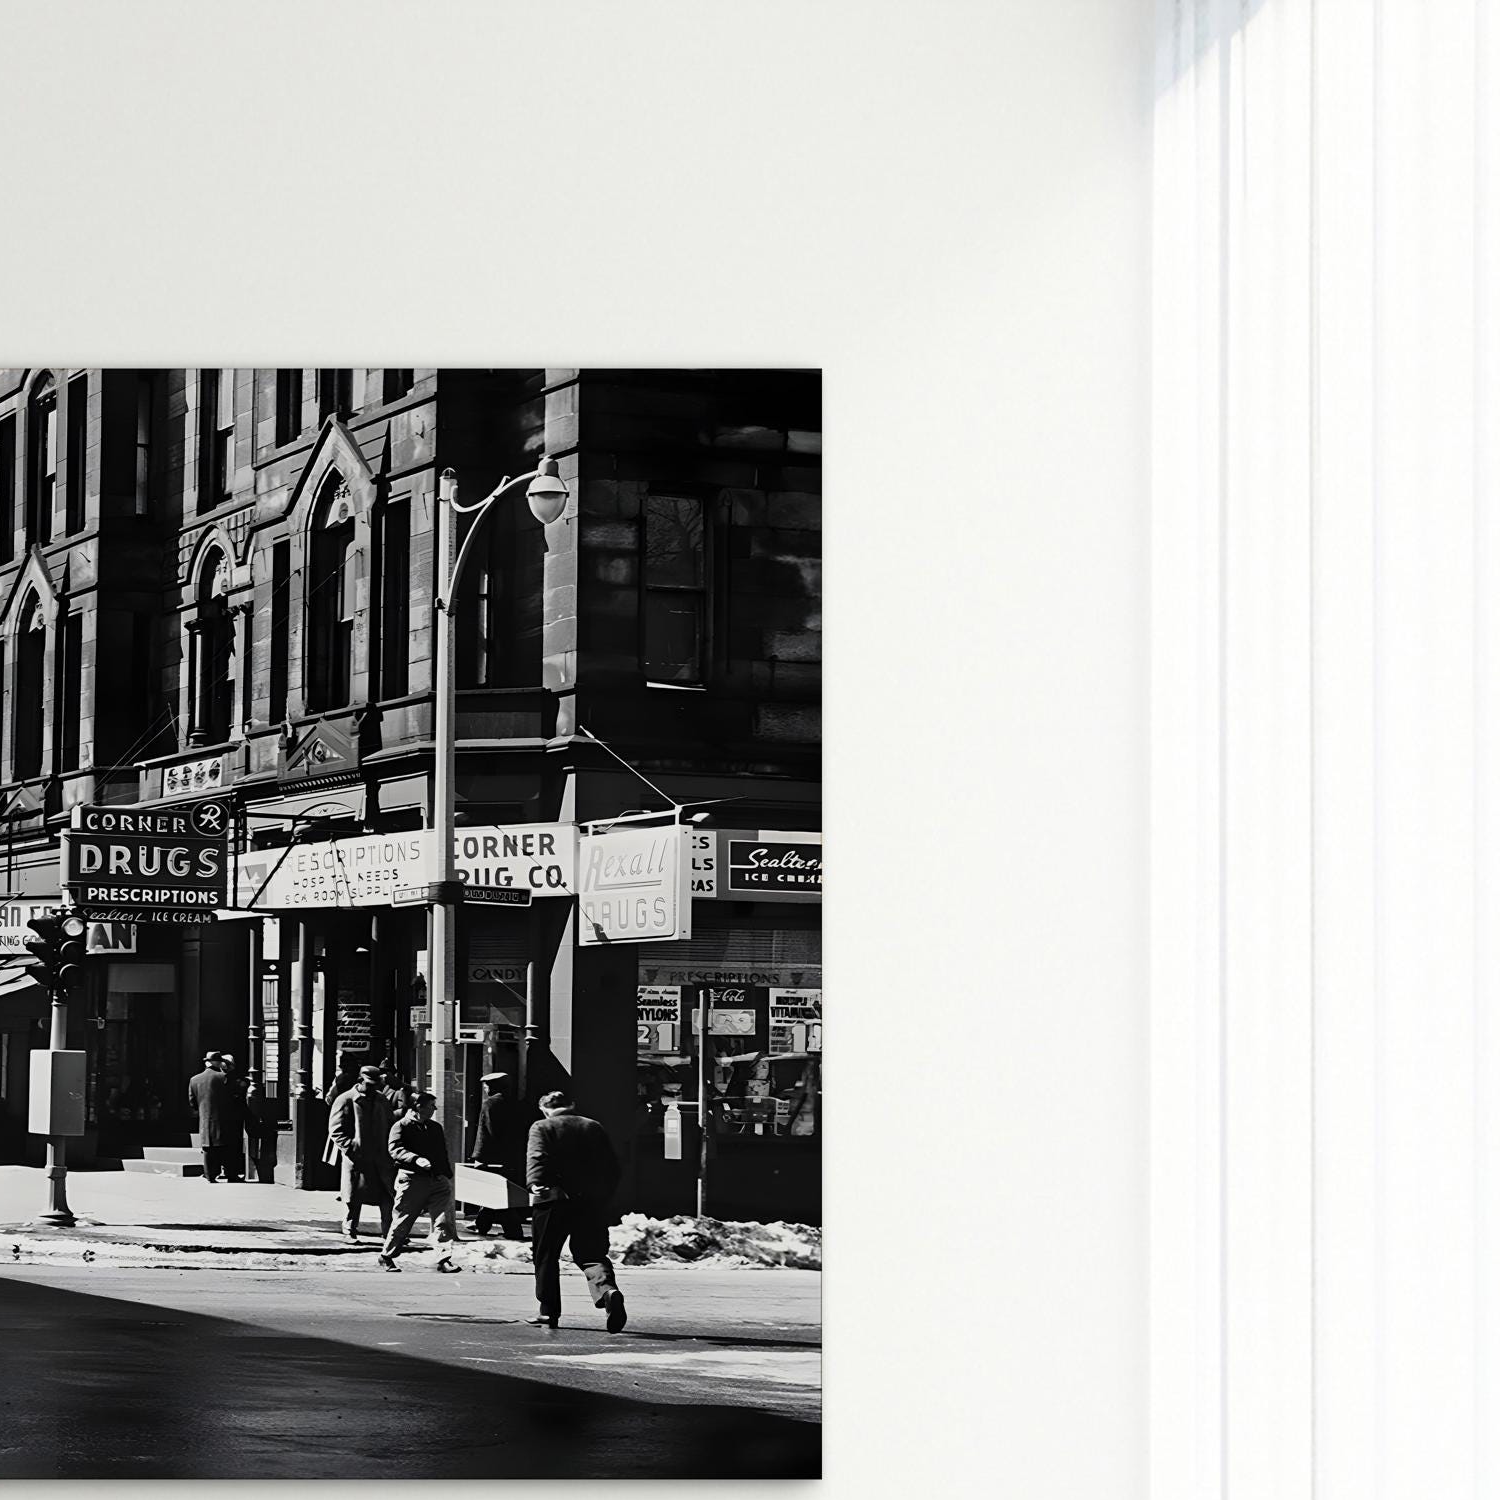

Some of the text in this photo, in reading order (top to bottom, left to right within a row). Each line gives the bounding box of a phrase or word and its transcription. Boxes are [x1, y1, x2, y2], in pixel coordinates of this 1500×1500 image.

[86, 813, 186, 832] CORNER
[277, 840, 421, 873] RESCRIPTIONS
[454, 833, 556, 859] CORNER
[79, 844, 219, 877] DRUGS
[584, 839, 668, 892] Rexall
[455, 865, 567, 889] RUG CO.
[87, 887, 219, 905] PRESCRIPTIONS
[152, 911, 169, 922] ICE
[172, 912, 212, 923] CREAM
[586, 897, 666, 931] DRUGS
